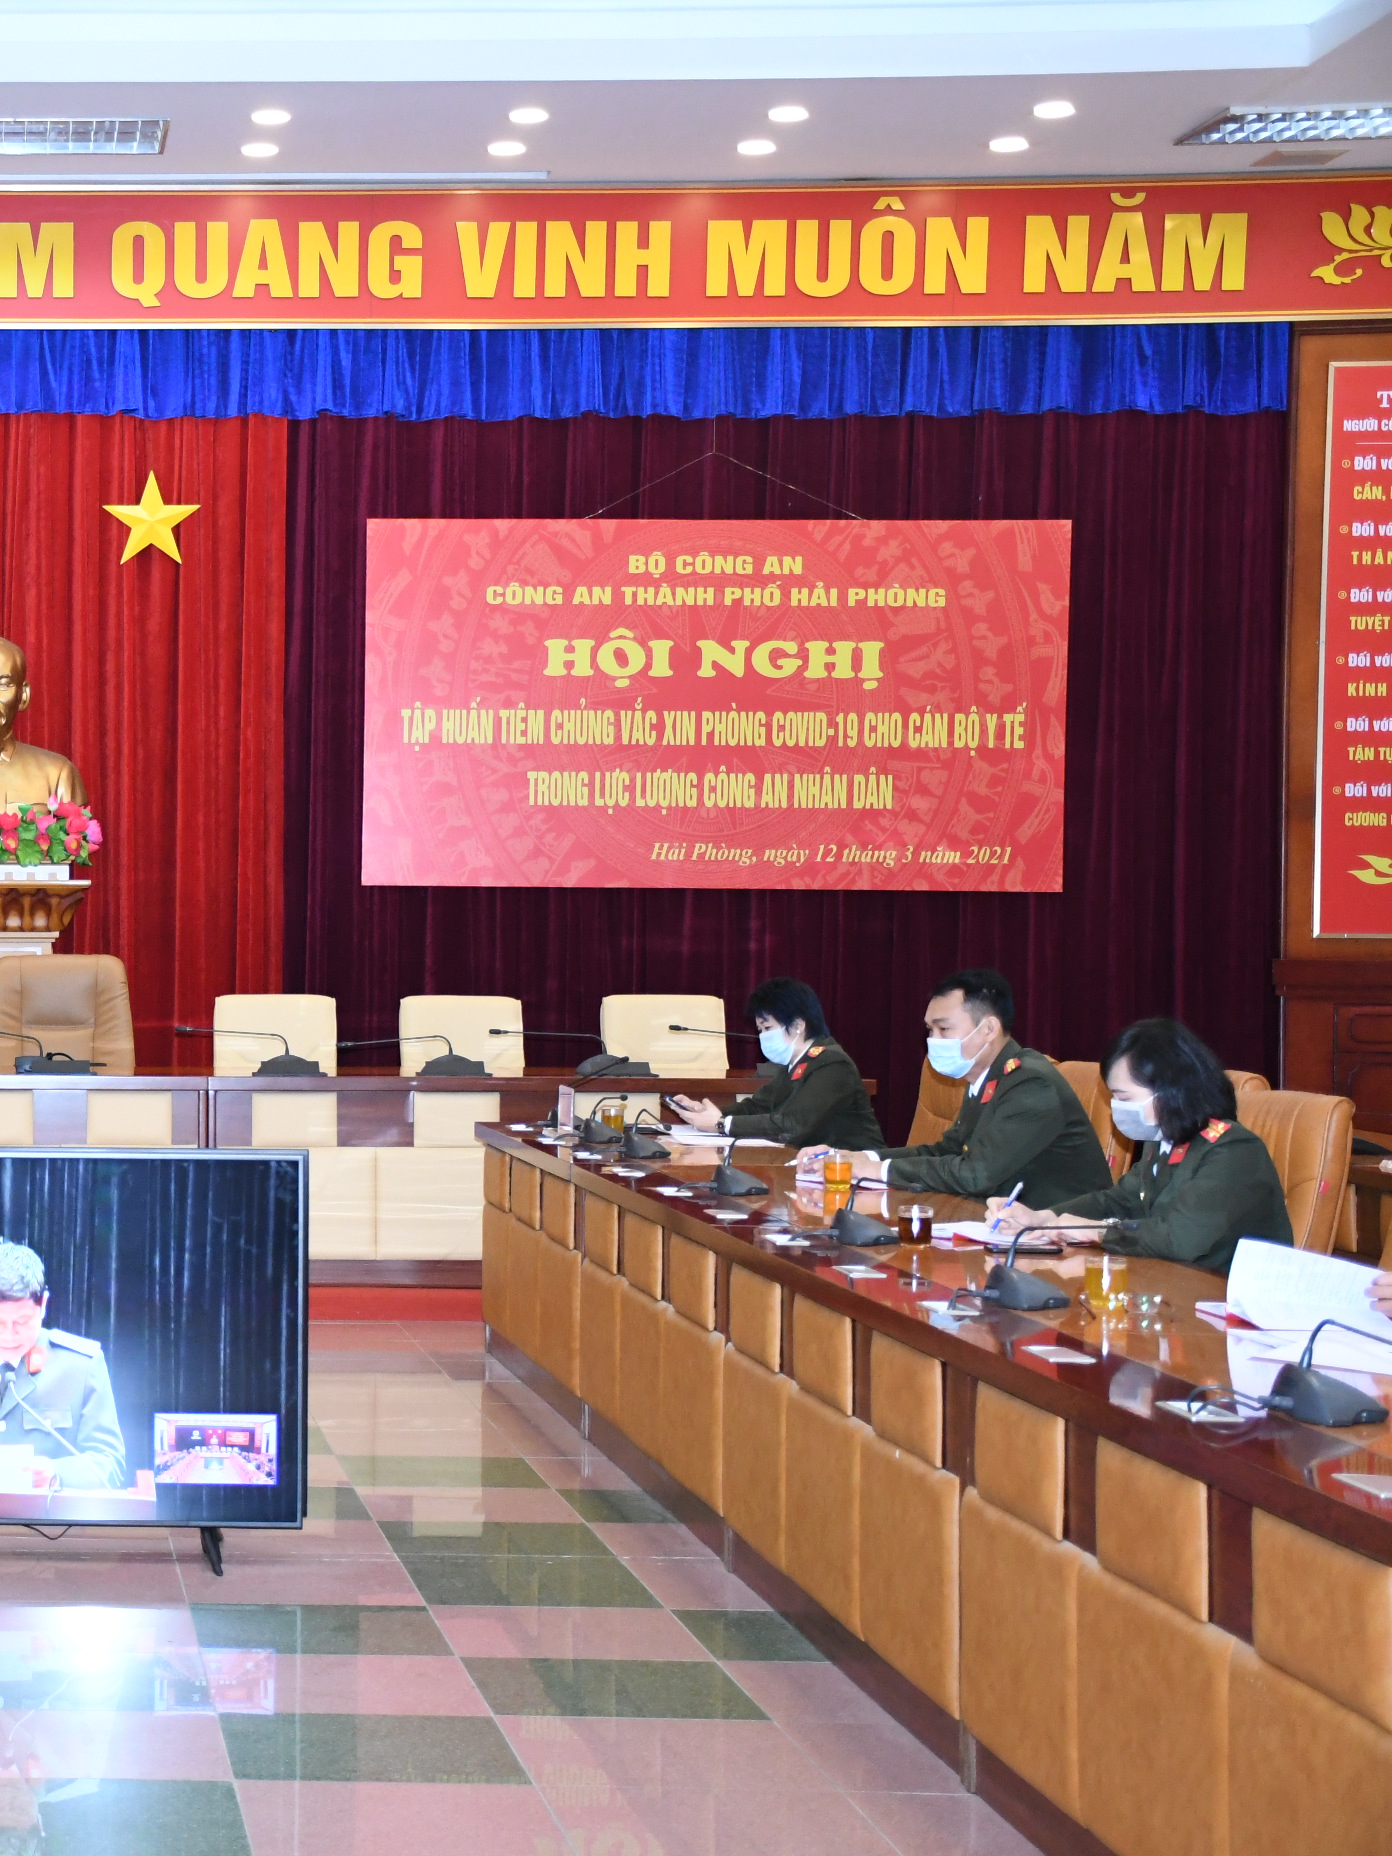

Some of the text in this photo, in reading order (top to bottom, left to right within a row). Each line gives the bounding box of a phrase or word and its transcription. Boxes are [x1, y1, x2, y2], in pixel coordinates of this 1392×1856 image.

[112, 219, 422, 307] QUANG
[457, 221, 671, 297] VINH
[706, 197, 989, 297] MUÔN
[1023, 193, 1247, 292] NĂM
[629, 552, 802, 578] BỘ CÔNG AN
[486, 581, 945, 607] CÔNG AN THÀNH PHỐ HẢI PHÒNG
[543, 628, 884, 689] HỘI NGHỊ
[1348, 681, 1386, 696] KÍNH
[401, 697, 1027, 756] TẬP HUẤN TIÊM CHỦNG VẮC XIN PHÒNG COVID-19 CHO CÁN BỘ Y TẾ
[527, 766, 892, 815] TRONG LỰC LƯỢNG CÔNG AN NHÂN DÂN
[651, 843, 1011, 867] Hải Phòng, ngày 12 tháng 3 năm 2021
